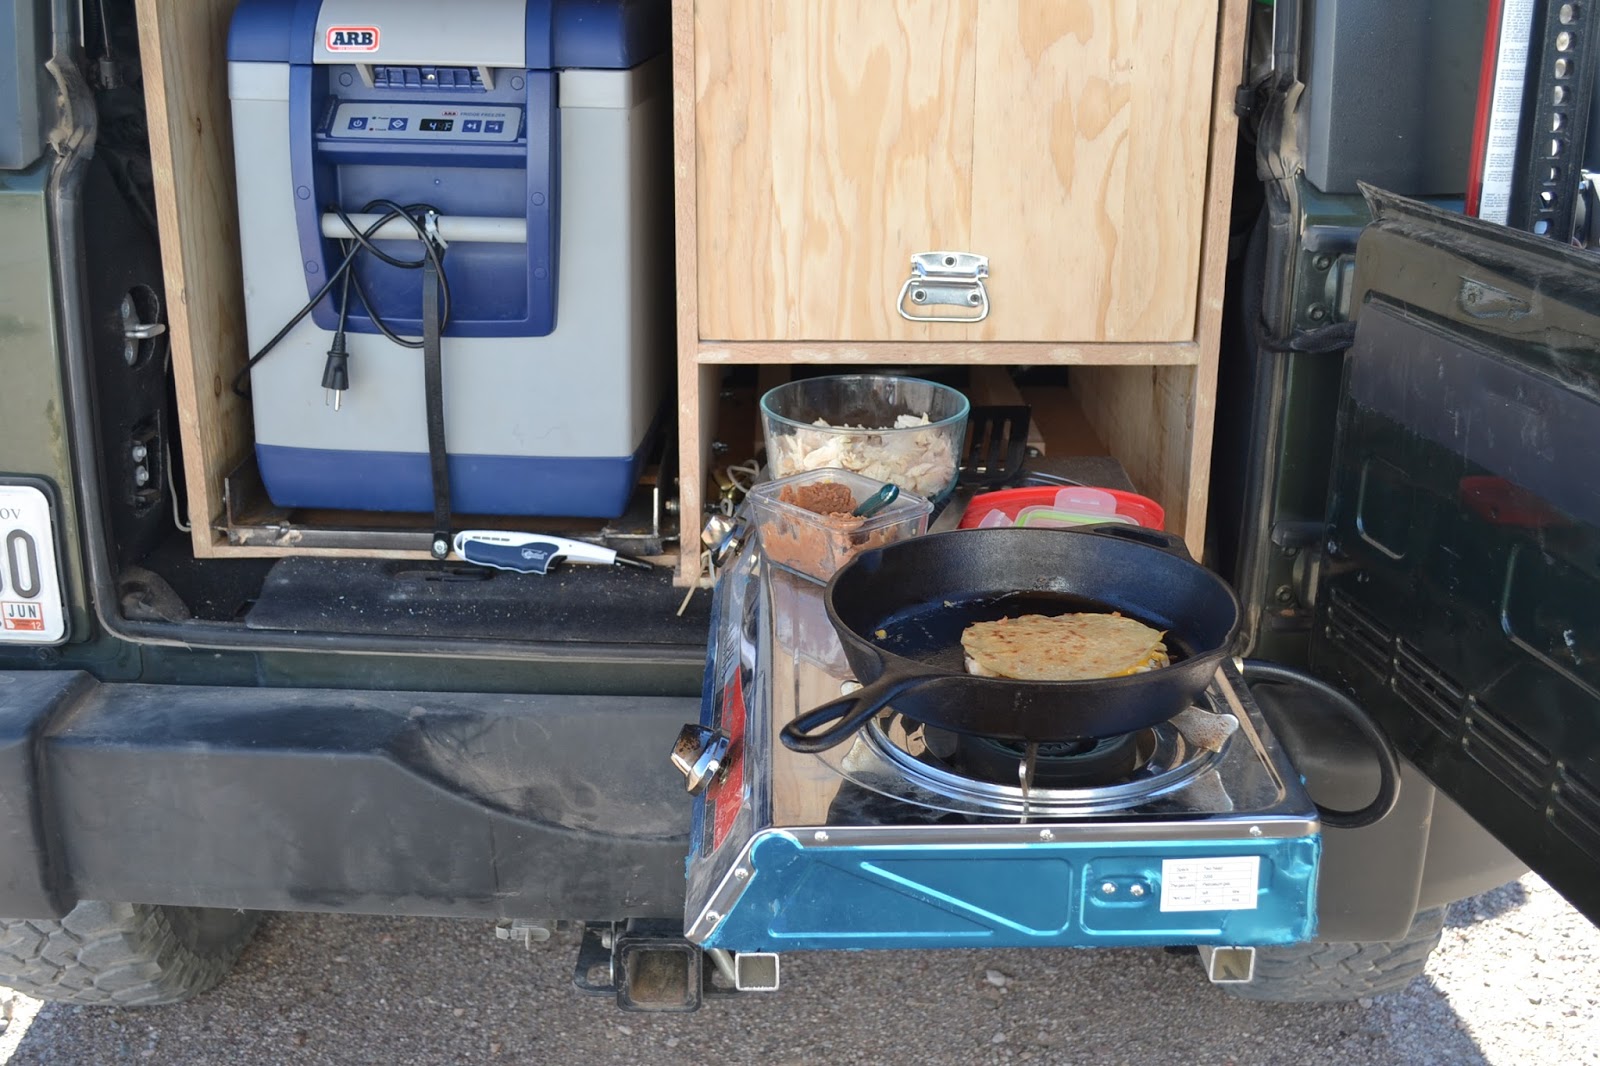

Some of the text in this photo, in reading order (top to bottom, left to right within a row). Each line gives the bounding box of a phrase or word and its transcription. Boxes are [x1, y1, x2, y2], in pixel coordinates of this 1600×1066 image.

[332, 31, 374, 46] ARB
[0, 528, 41, 599] 0
[9, 603, 37, 619] JUN
[31, 621, 42, 630] 12
